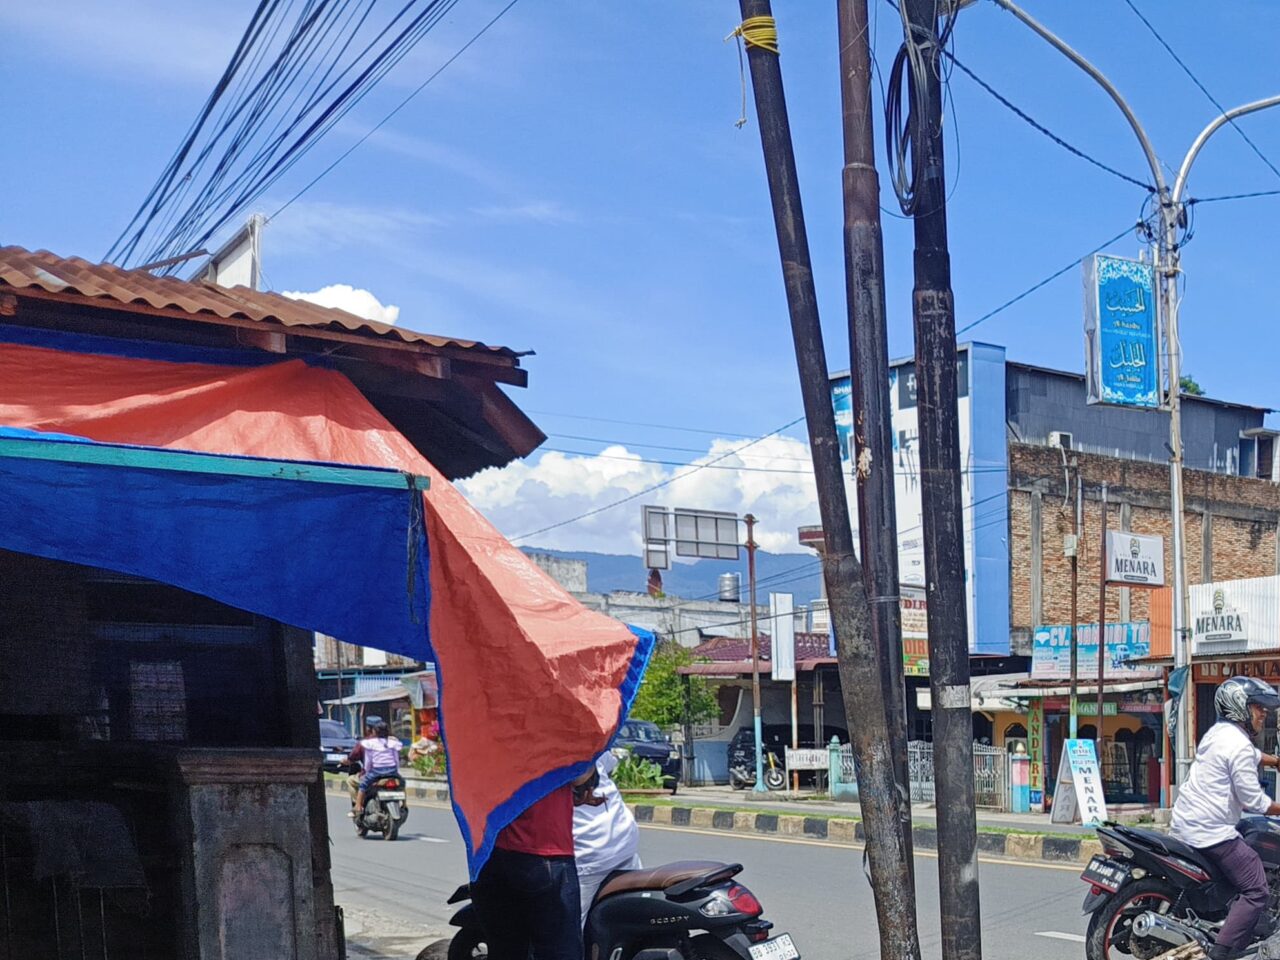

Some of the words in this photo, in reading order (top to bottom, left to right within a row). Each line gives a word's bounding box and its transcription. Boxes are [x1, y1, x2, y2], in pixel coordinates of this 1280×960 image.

[1114, 557, 1157, 577] MENARA
[1195, 614, 1242, 635] MENARA
[1032, 700, 1040, 788] MANDIRI
[1079, 767, 1100, 823] MENARA
[650, 915, 690, 925] SCOOPY
